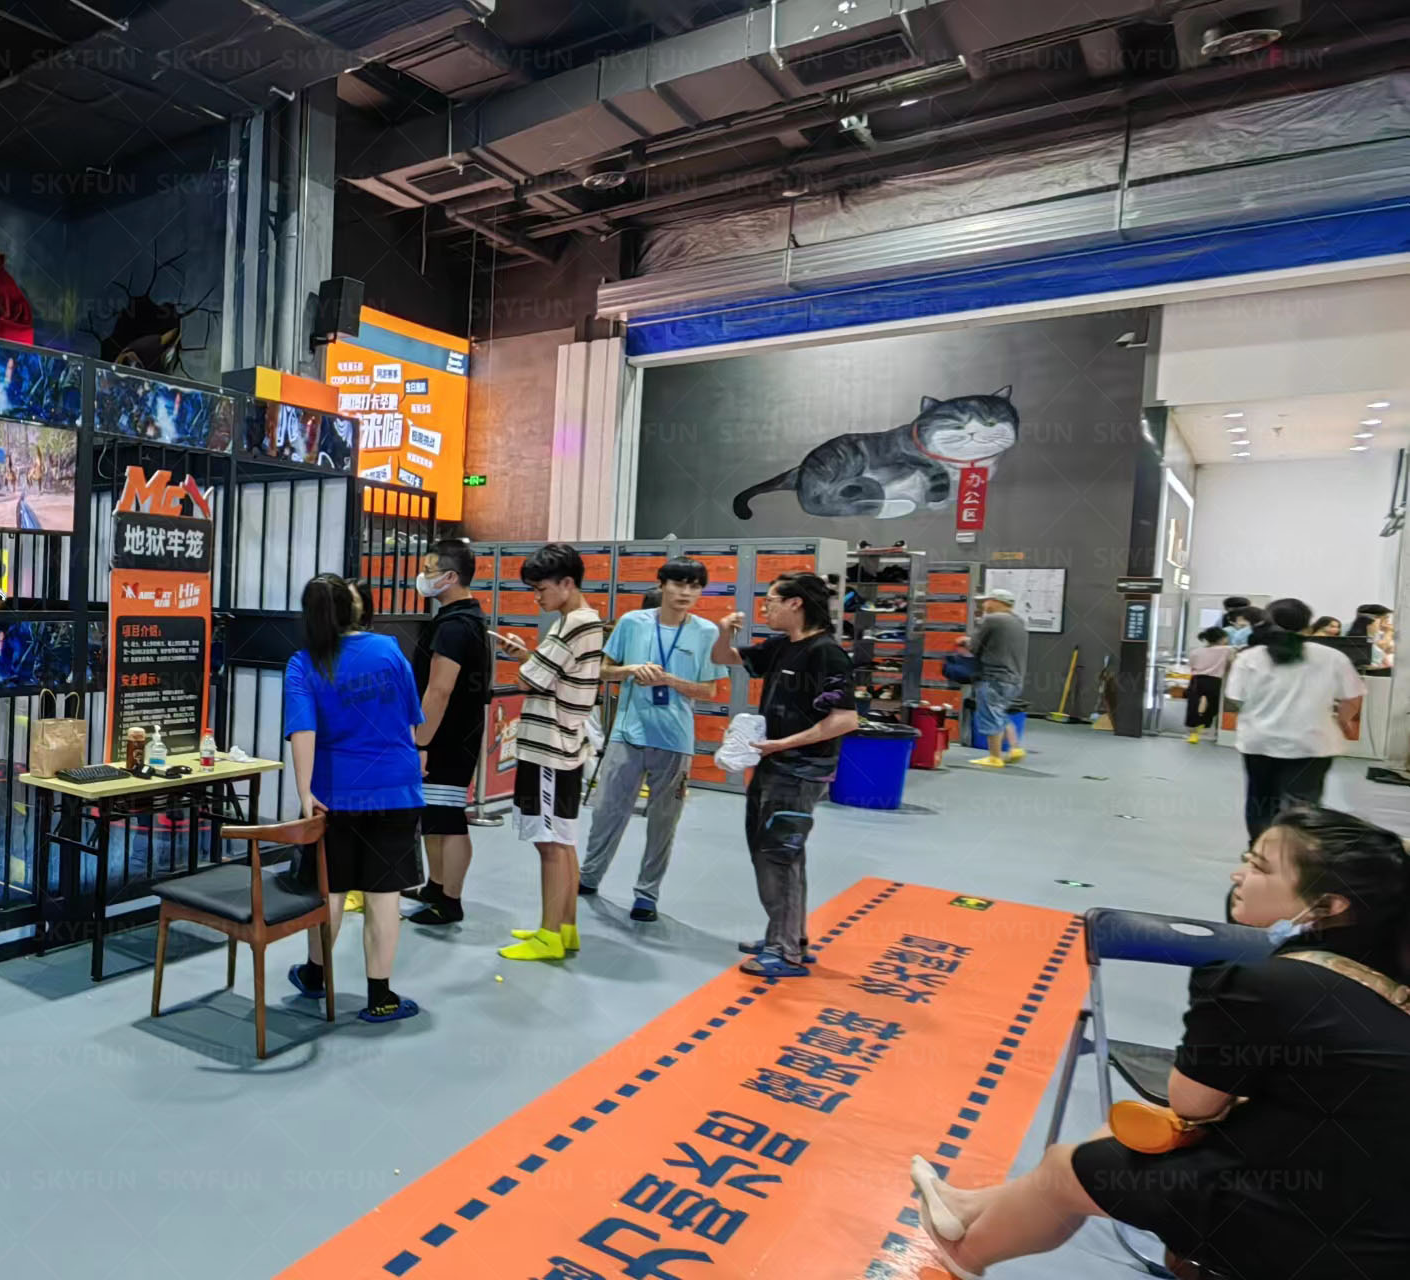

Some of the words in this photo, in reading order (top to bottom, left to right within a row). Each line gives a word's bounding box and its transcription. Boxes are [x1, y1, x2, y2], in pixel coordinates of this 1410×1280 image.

[343, 412, 404, 449] 来嗨
[962, 473, 986, 523] 办公区
[123, 523, 205, 559] 地狱牢笼
[739, 1007, 907, 1115] 魔鬼滑梯
[848, 933, 975, 1004] 炫光隧道
